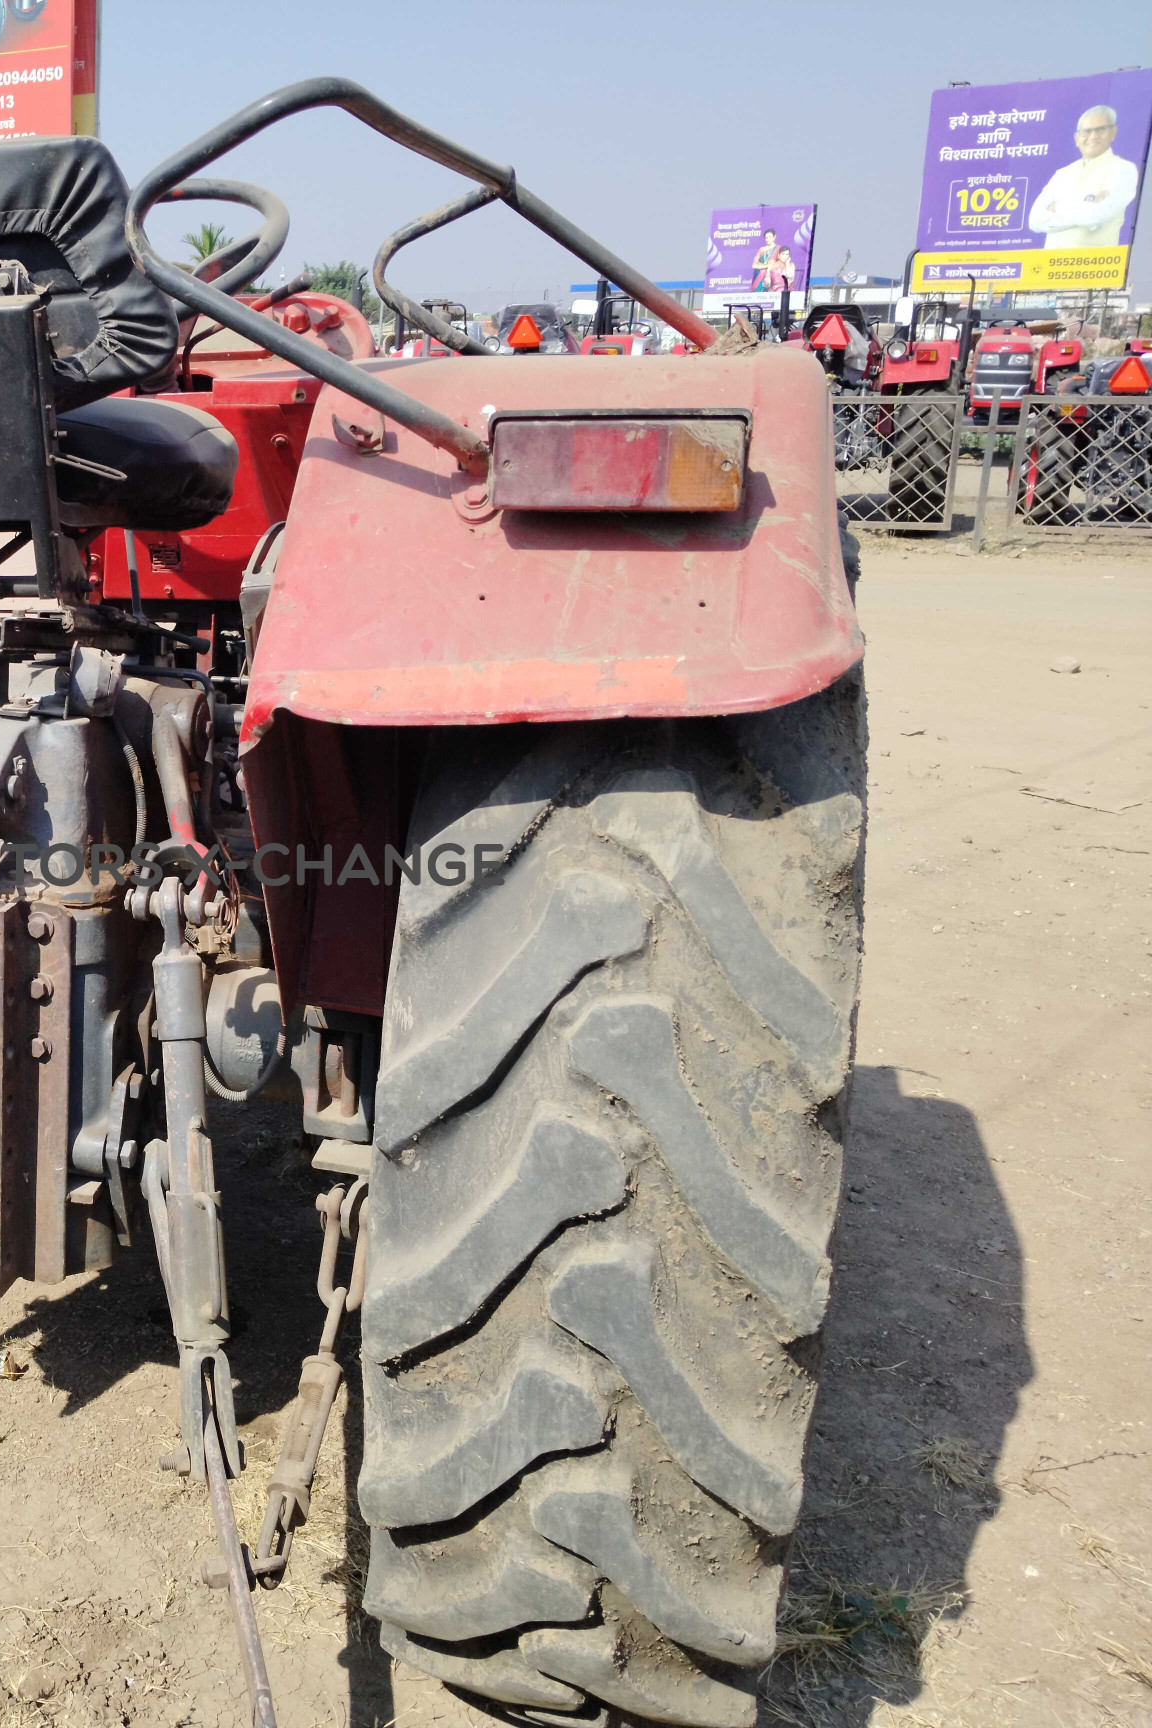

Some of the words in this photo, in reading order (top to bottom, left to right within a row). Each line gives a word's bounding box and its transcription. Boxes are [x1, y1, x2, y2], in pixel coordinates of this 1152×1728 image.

[949, 112, 969, 130] इथे
[971, 110, 996, 126] आहे
[998, 108, 1047, 124] खरेपणा
[977, 128, 1012, 144] आणि
[939, 144, 1005, 162] विश्वासाची
[1006, 143, 1049, 158] परंपरा!
[960, 214, 1011, 228] व्याजदर
[1049, 256, 1121, 267] 9552864000
[1048, 269, 1119, 280] 9552865000
